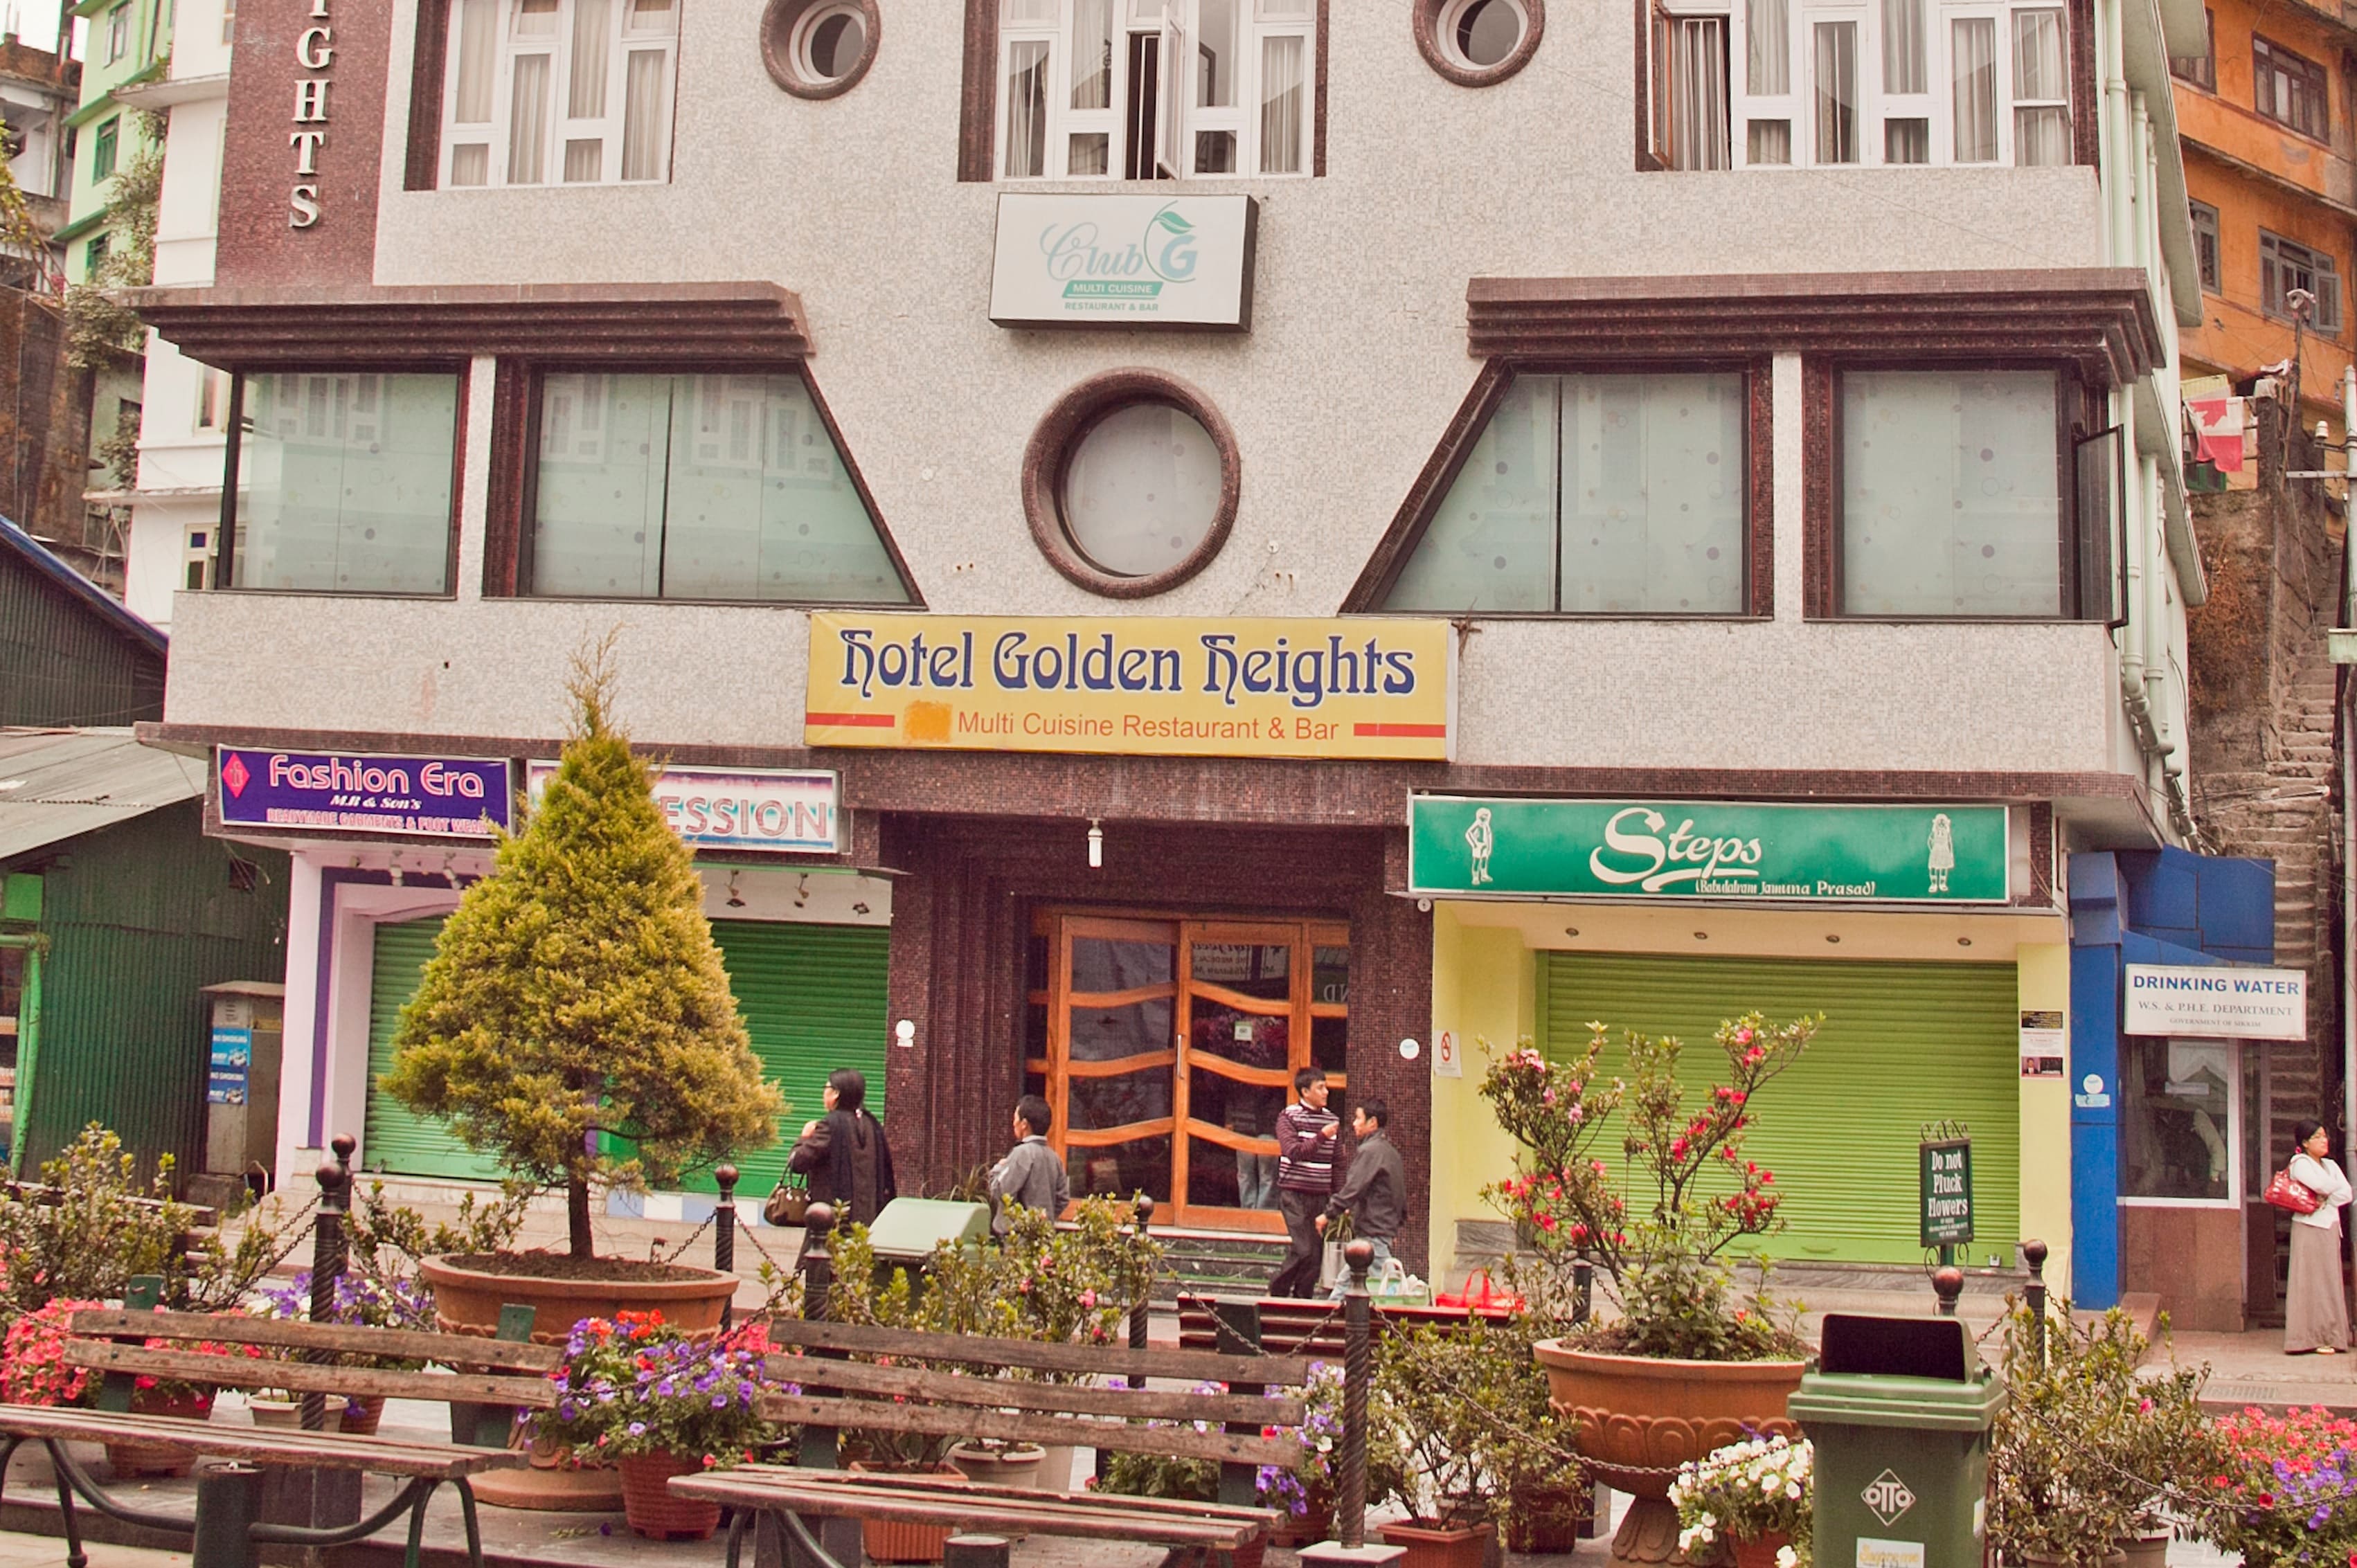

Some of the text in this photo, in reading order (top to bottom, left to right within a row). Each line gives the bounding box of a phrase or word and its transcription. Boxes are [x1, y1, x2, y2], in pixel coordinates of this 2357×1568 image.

[1040, 222, 1144, 280] Club
[1073, 282, 1153, 294] MULTI CUISINE
[1064, 302, 1158, 312] RESTAURANT & BAR
[840, 629, 1415, 708] Hotel Golden Heights
[958, 712, 1339, 740] Multi Cuisine Restaurant & Bar
[269, 755, 409, 794] Fashion
[420, 762, 484, 797] Era
[363, 796, 377, 808] &
[339, 811, 404, 829] GARMENTS
[1588, 806, 1762, 892] Steps
[2133, 975, 2300, 995] DRINKING WATER
[2138, 1001, 2293, 1016] W.S. & P.H.E. DEPARTMENT
[2169, 1017, 2221, 1026] GOVERNMENT
[1931, 1151, 1962, 1171] Do not
[1933, 1173, 1962, 1193] Pluck
[1928, 1198, 1968, 1217] Flowers
[1866, 1481, 1910, 1512] OTTO
